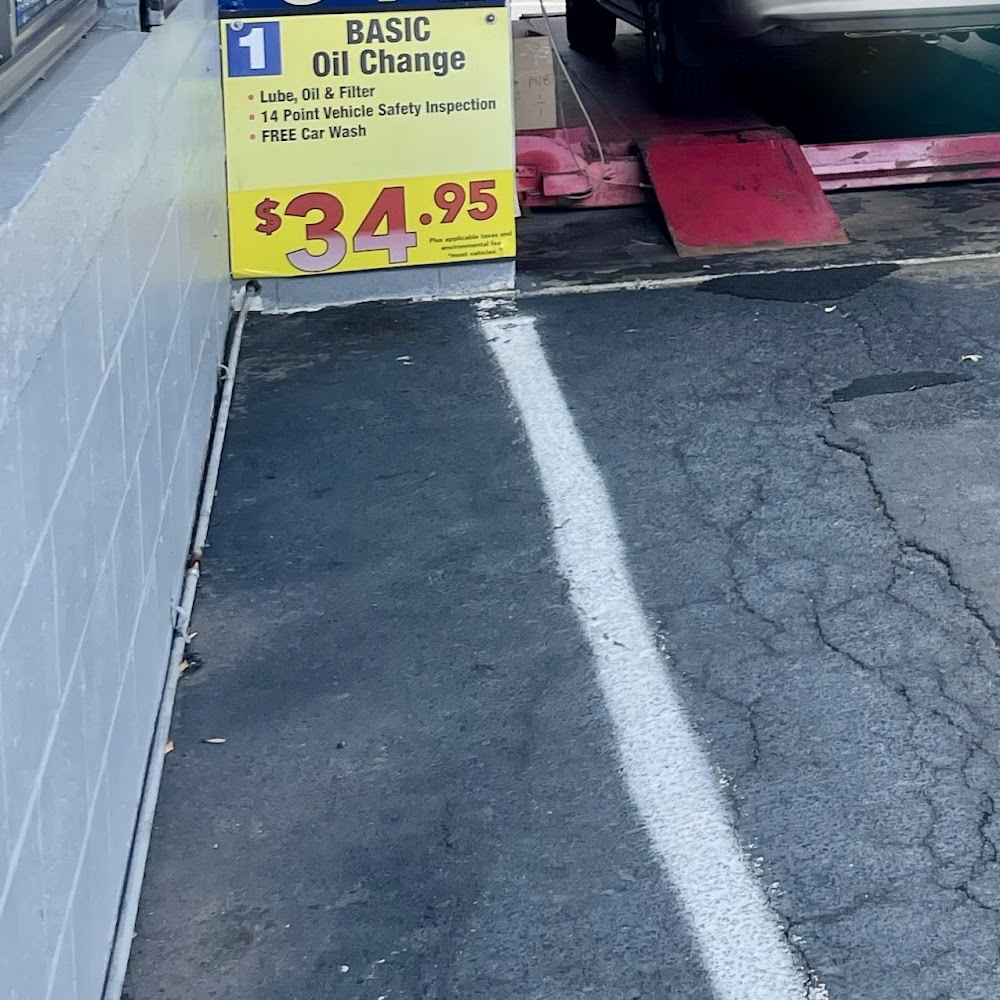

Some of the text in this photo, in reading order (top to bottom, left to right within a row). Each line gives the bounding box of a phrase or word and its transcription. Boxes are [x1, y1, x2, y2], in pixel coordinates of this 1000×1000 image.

[346, 16, 431, 45] BASIC
[239, 27, 265, 70] 1
[312, 49, 466, 77] Oil Change
[260, 86, 375, 104] Lube, Oil & Filter
[261, 98, 496, 122] 14 Point Vehicle Safety Inspection
[262, 125, 367, 142] FREE Car Wash
[255, 179, 498, 272] $34.95
